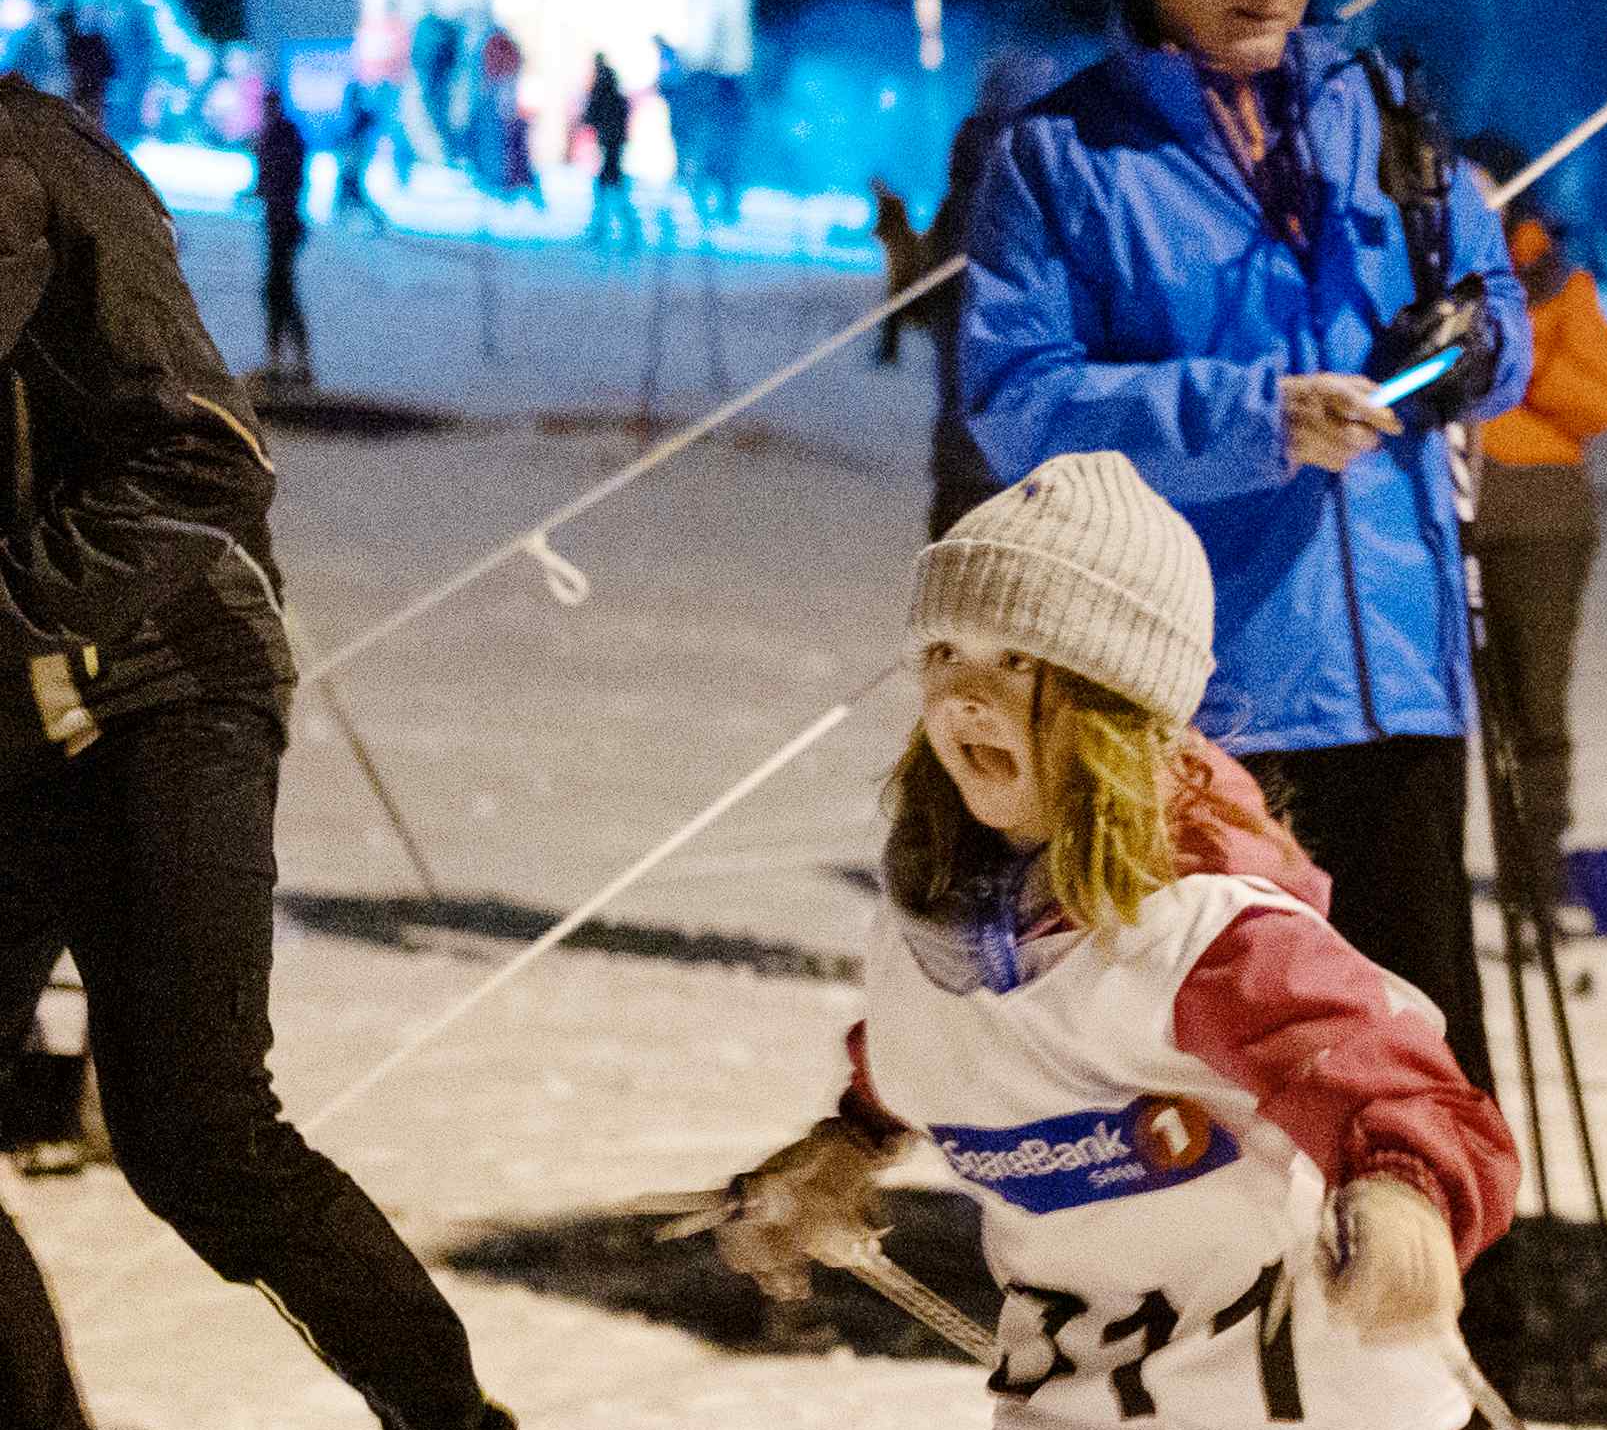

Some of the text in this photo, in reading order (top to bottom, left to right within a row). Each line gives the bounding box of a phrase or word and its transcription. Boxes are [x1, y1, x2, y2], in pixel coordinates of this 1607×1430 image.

[940, 1106, 1191, 1182] SpareBank 1
[986, 1258, 1304, 1422] 311
